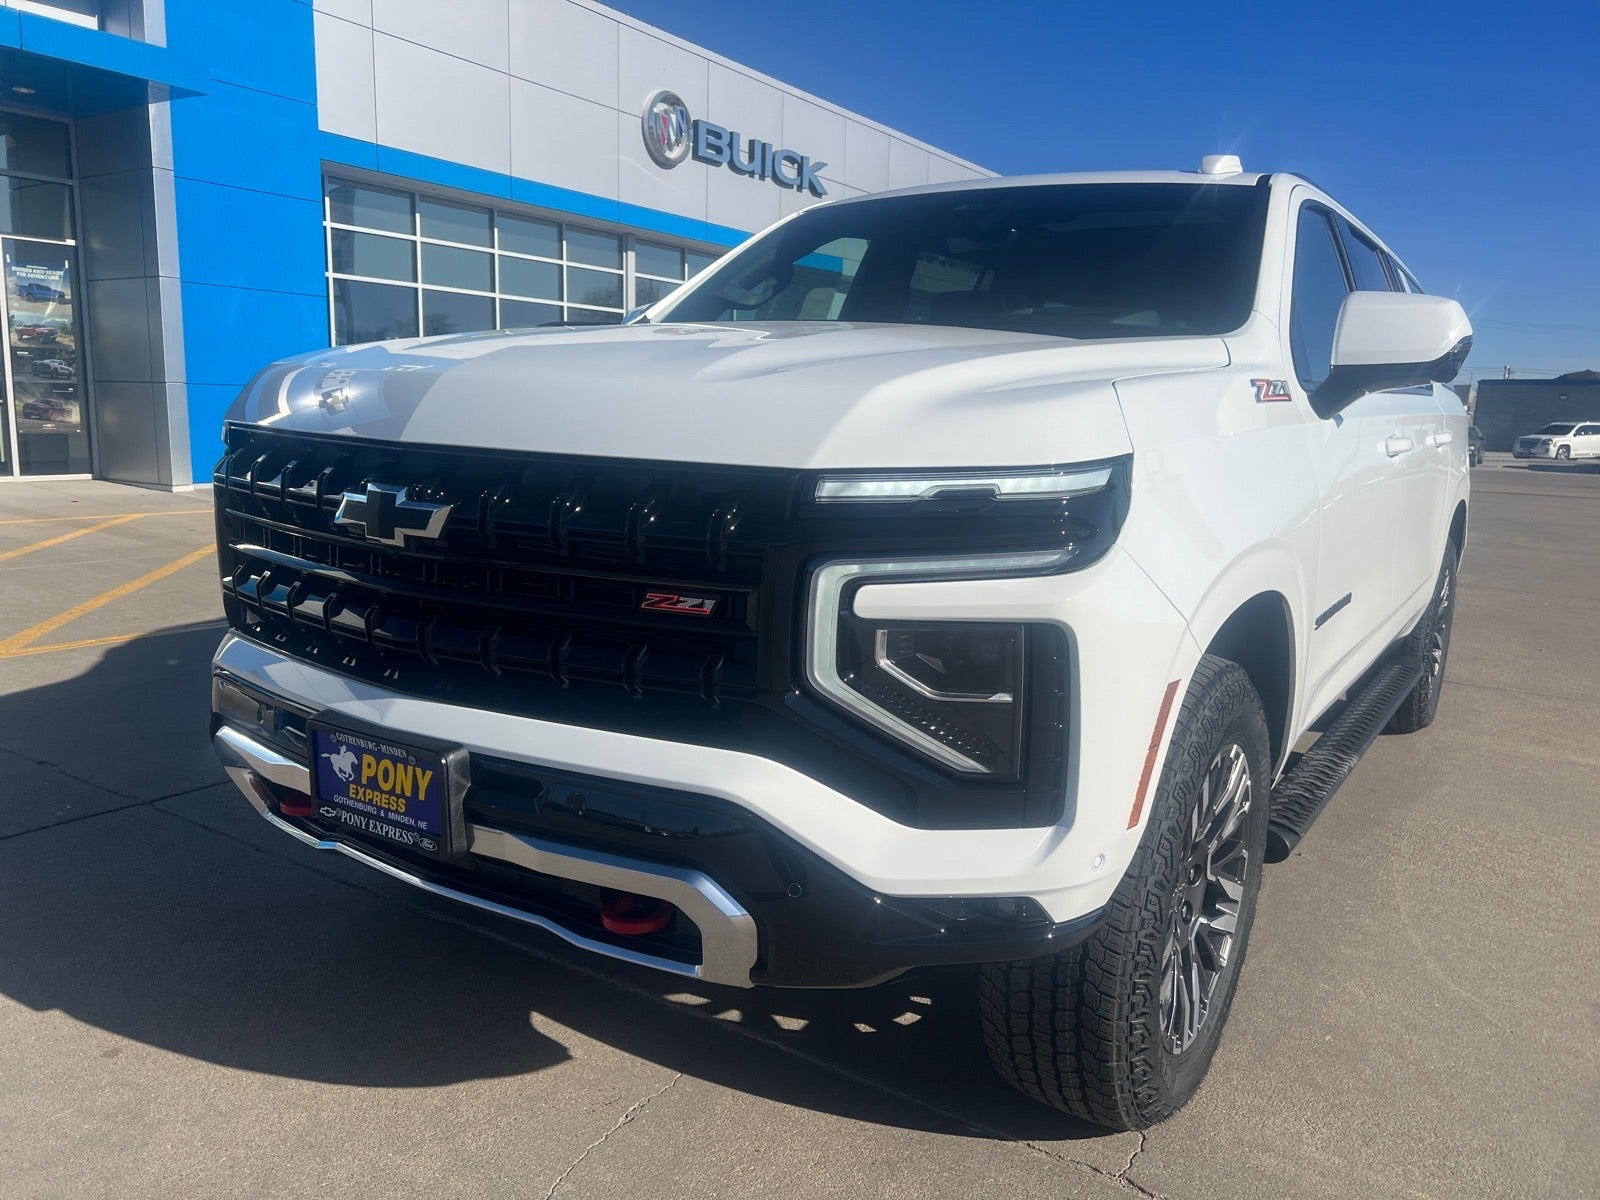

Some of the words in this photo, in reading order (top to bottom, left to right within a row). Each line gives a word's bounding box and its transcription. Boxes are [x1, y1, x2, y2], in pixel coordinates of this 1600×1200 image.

[692, 119, 828, 199] BUICK
[1250, 379, 1292, 403] Z71
[641, 593, 716, 615] Z71
[361, 753, 433, 801] PONY
[333, 794, 377, 815] GOTHENBURG
[380, 809, 385, 817] &
[387, 811, 417, 828] MINDEN,
[417, 820, 428, 830] NE
[349, 783, 406, 813] EXPRESS
[341, 810, 368, 830] PONY
[369, 819, 414, 845] EXPRESS
